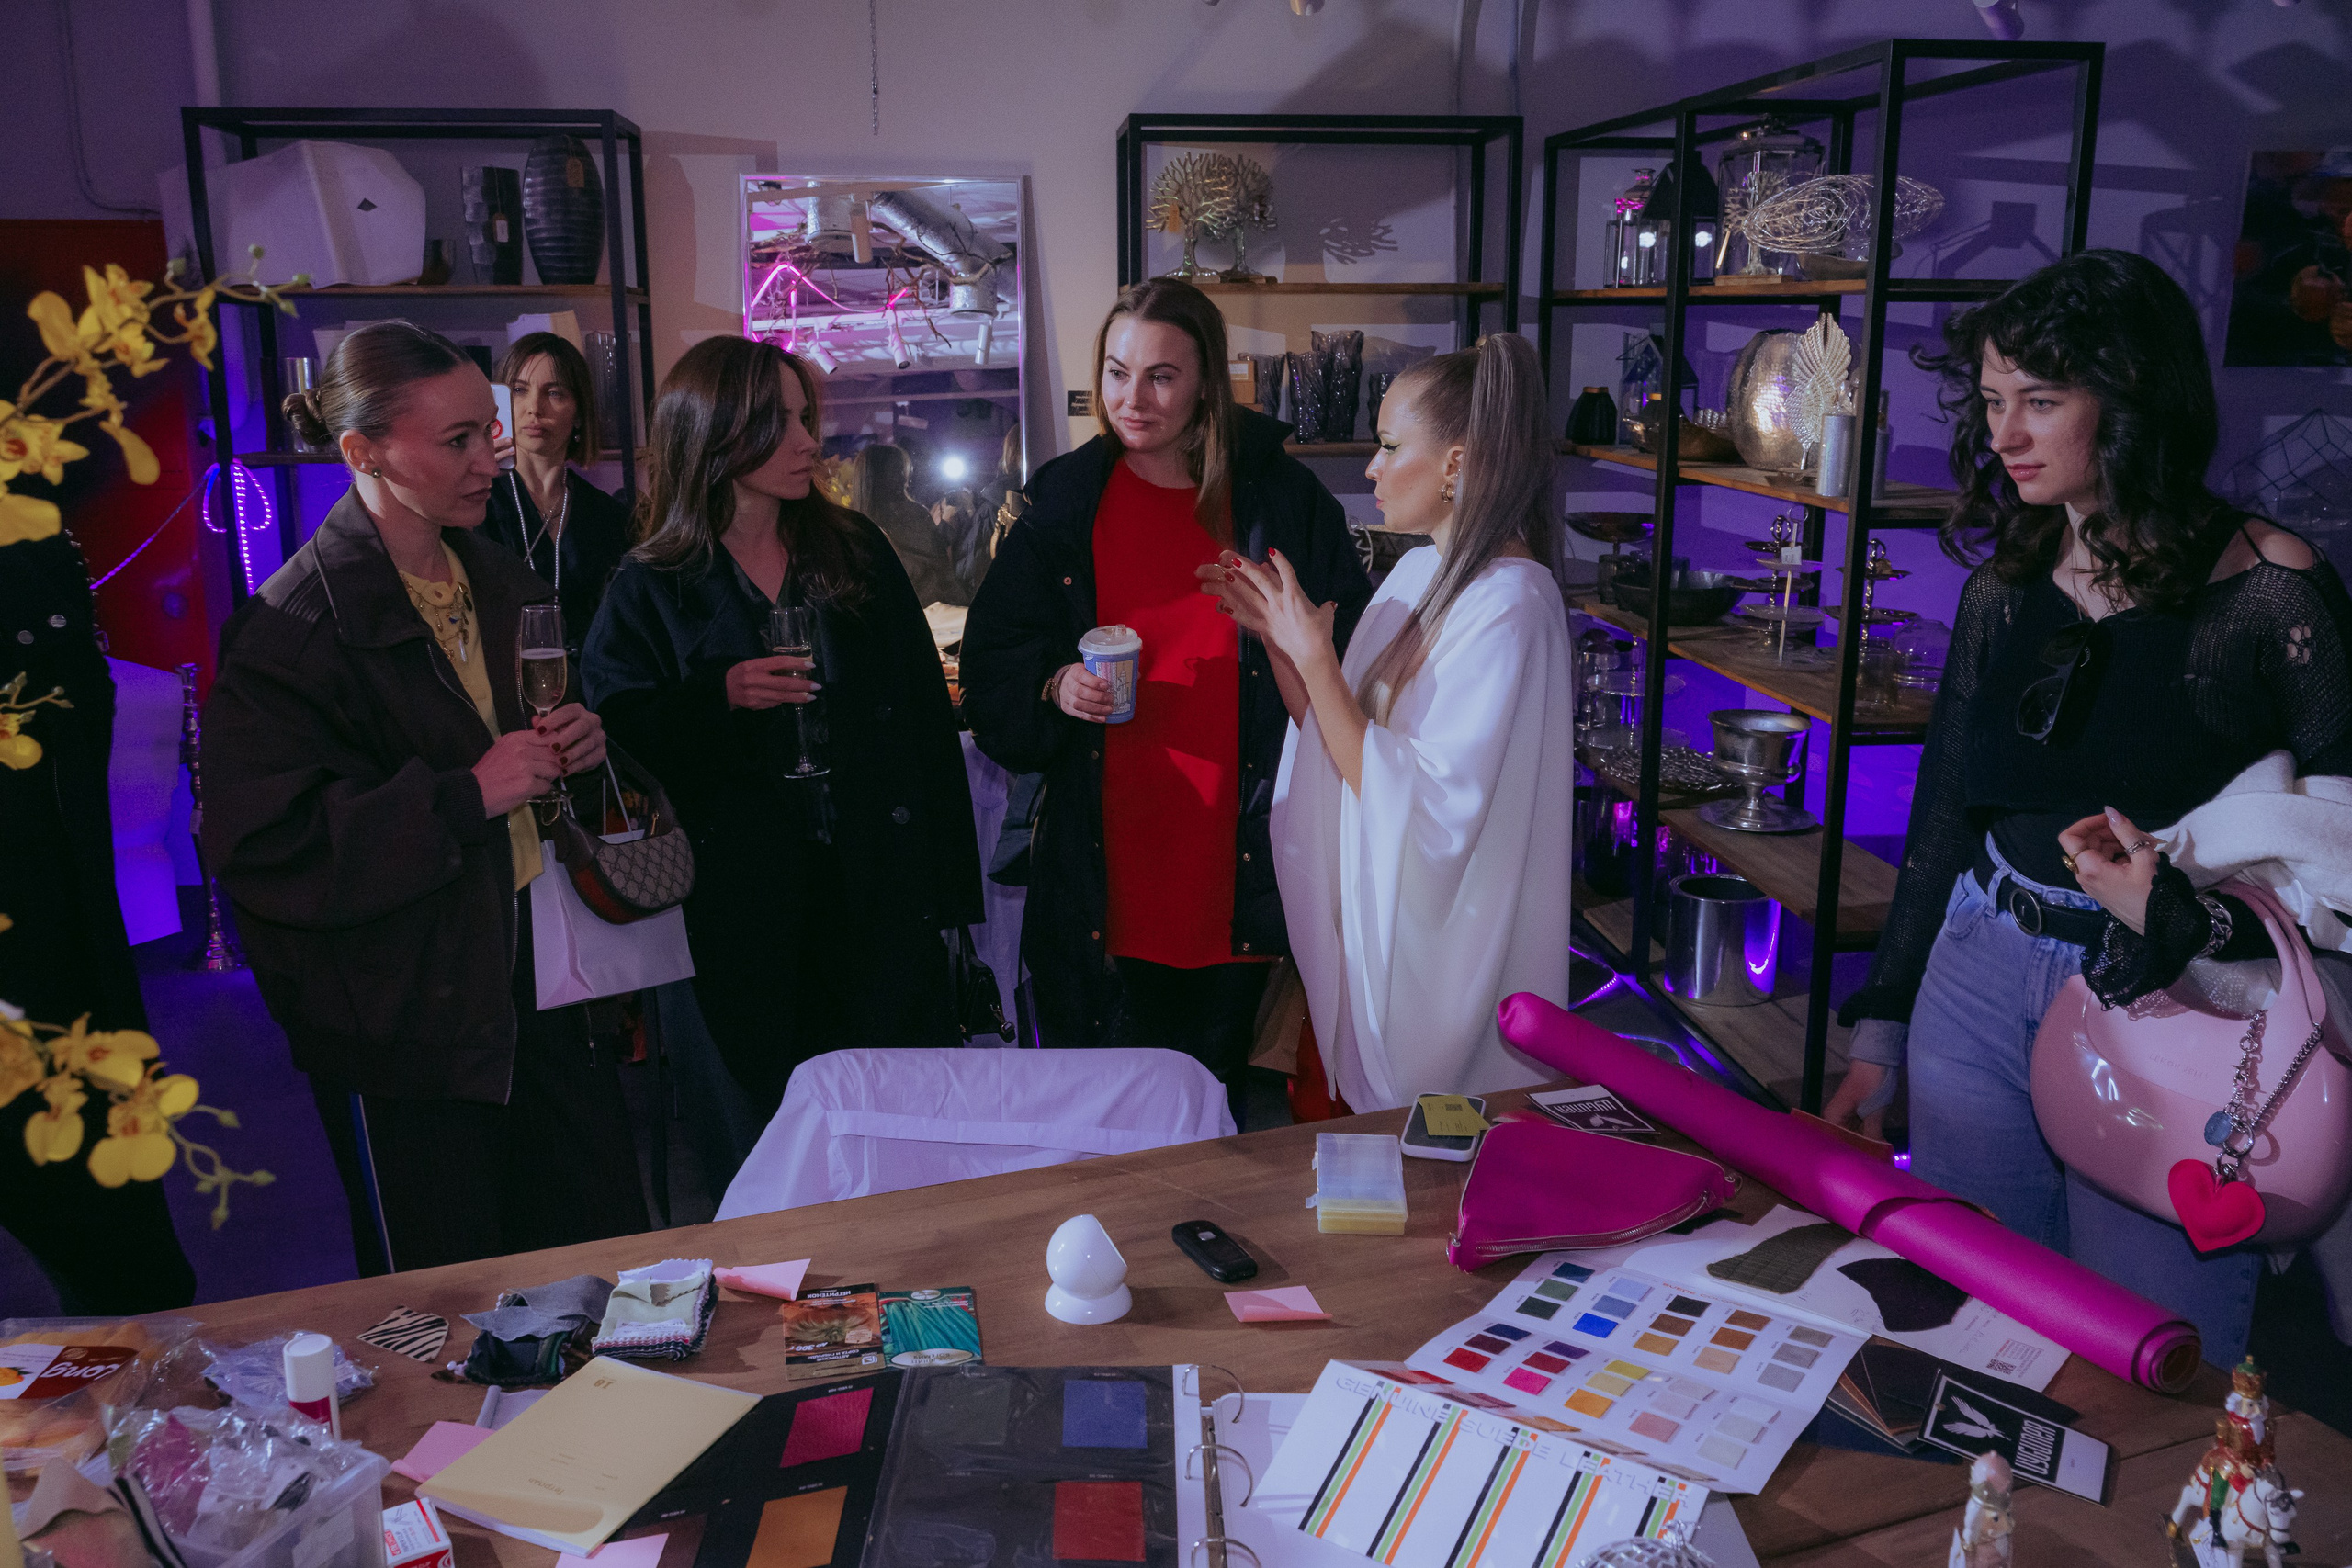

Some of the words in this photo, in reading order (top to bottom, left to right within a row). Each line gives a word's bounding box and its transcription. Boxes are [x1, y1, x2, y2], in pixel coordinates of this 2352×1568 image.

[796, 1344, 815, 1352] 300
[594, 1379, 615, 1390] 18
[1336, 1377, 1450, 1424] GENUINE
[1458, 1416, 1552, 1459] SUEDE
[1560, 1450, 1690, 1508] LEATHER
